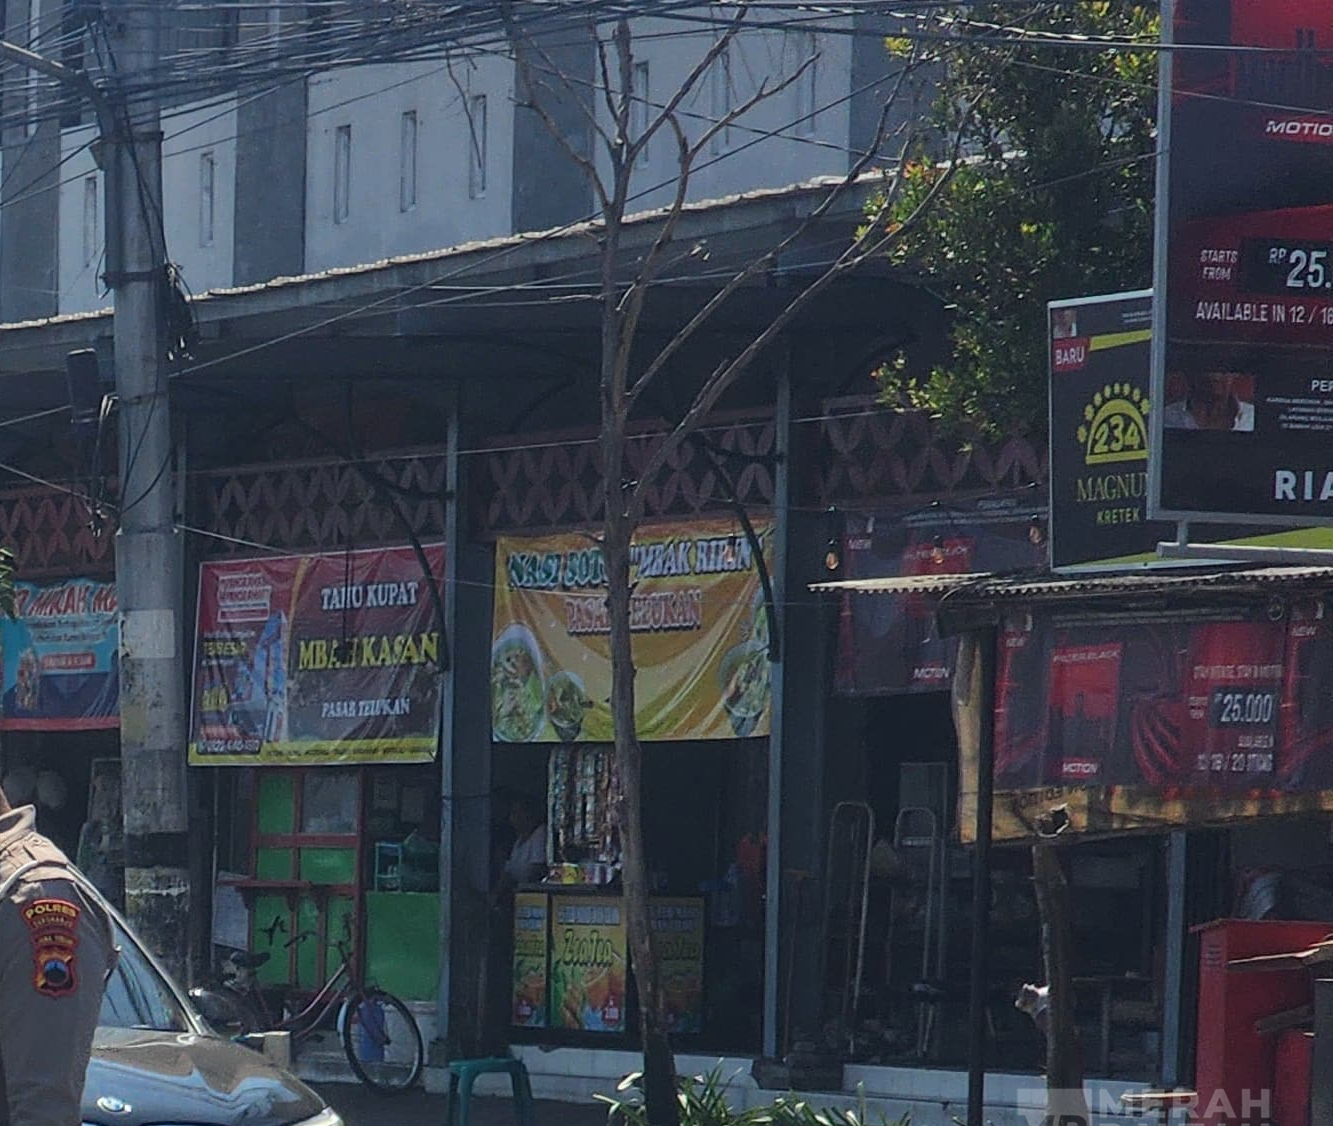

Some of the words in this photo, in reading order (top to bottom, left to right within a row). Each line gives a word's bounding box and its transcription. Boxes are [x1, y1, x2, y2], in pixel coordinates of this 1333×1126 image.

[1200, 250, 1238, 263] STARTS
[1202, 267, 1231, 281] FROM
[1196, 302, 1268, 322] AVAILABLE
[1272, 304, 1286, 323] IN
[1289, 305, 1305, 323] 12
[1308, 306, 1318, 324] /
[1055, 347, 1085, 366] BARU
[1093, 415, 1140, 453] 234
[1076, 472, 1149, 502] MAGNU
[1096, 507, 1140, 524] KRETEK
[321, 586, 363, 610] TAHU
[367, 582, 419, 606] KUPAT
[361, 632, 439, 667] KASAN
[321, 701, 356, 718] PASAR
[358, 699, 410, 717] TELUKAN
[1220, 693, 1273, 722] 25.000
[1062, 763, 1099, 773] MOTION
[25, 904, 77, 919] POLRES
